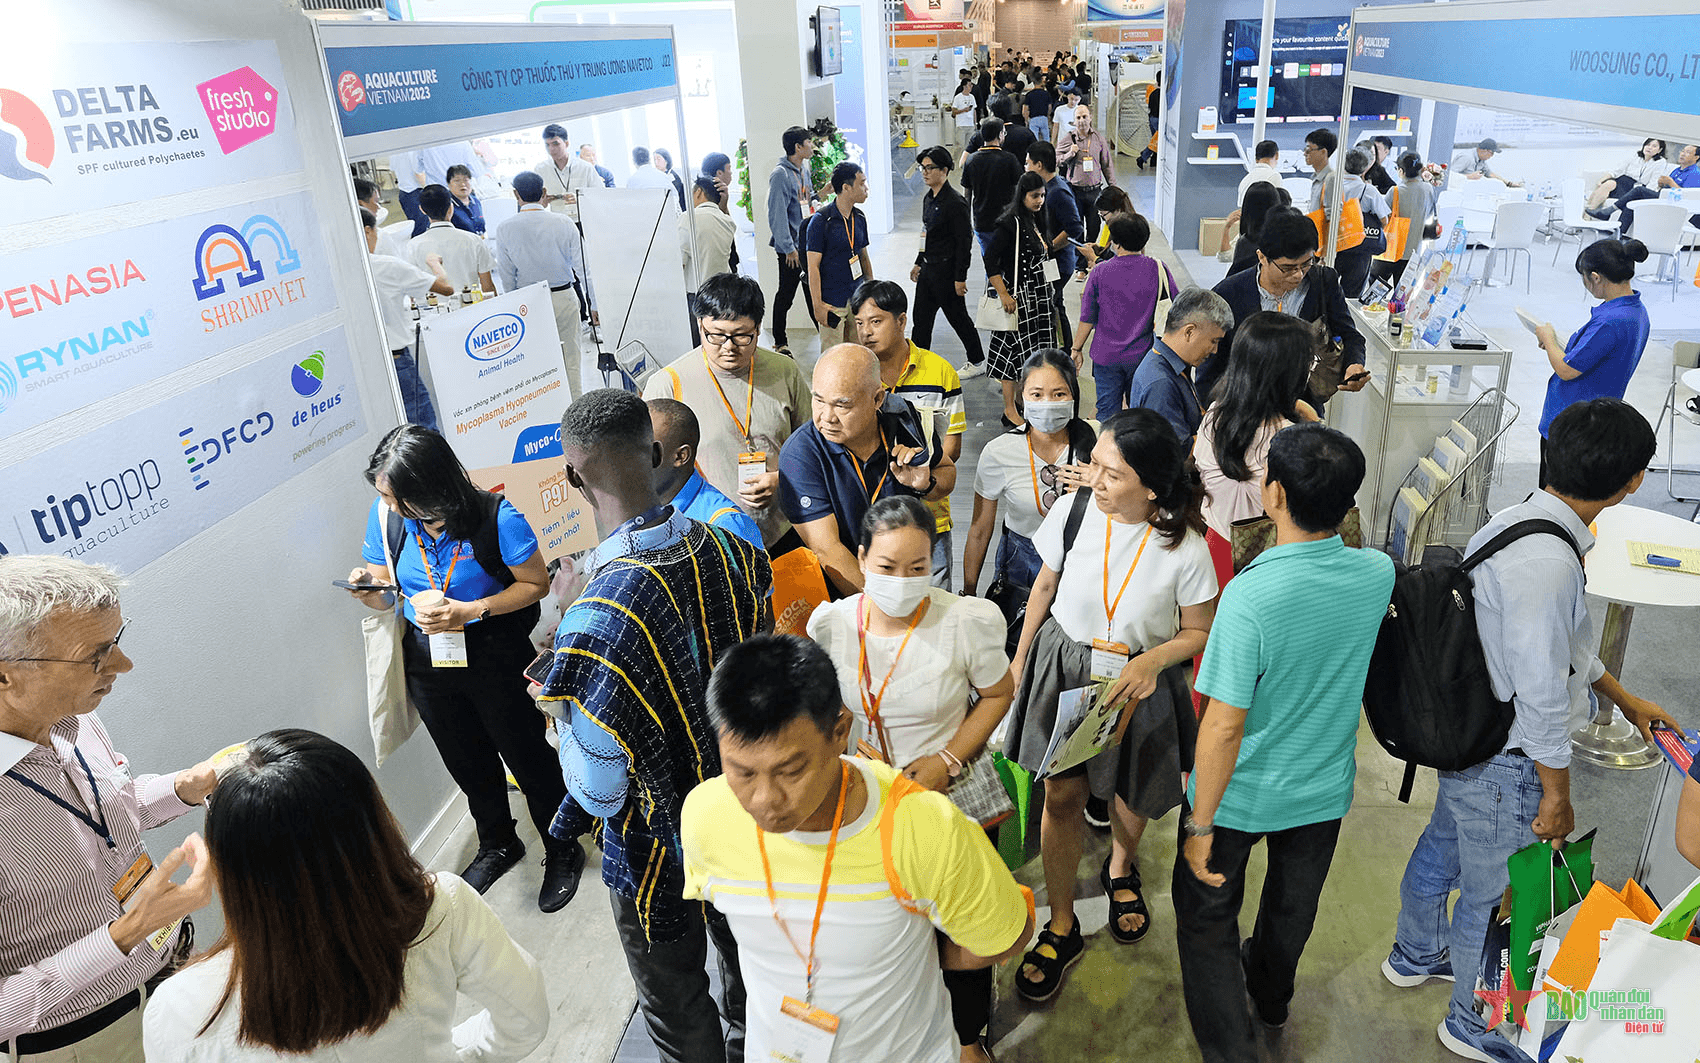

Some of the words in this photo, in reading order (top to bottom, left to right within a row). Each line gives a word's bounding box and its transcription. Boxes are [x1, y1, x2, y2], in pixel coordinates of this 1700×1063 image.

[365, 69, 438, 89] AQUACULTURE
[462, 68, 493, 92] CÔNG
[494, 70, 508, 87] TY
[511, 68, 524, 86] CP
[525, 62, 557, 84] THUỐC
[557, 61, 575, 81] THÚ
[575, 64, 580, 78] Y
[582, 61, 606, 77] TRUNG
[626, 57, 653, 72] NAVETCO
[1569, 50, 1641, 75] WOOSUNG
[1645, 52, 1674, 83] CO.,
[52, 84, 160, 119] DELTA
[206, 87, 254, 111] fresh
[218, 107, 271, 133] studio
[77, 163, 100, 175] SPF
[102, 157, 146, 173] cultured
[148, 149, 206, 166] Polychaetes
[200, 277, 309, 333] SHRIMPVET
[15, 316, 151, 379] RYNAN
[472, 322, 518, 349] NAVETCO
[487, 347, 500, 356] SINCE
[25, 365, 71, 394] SMART
[73, 340, 154, 375] AQUACULTURE
[478, 360, 502, 379] Animal
[503, 353, 525, 368] Health
[532, 367, 558, 381] Mycoplasma
[292, 410, 308, 427] de
[311, 393, 342, 417] heus
[456, 406, 505, 435] Mycoplasma
[506, 380, 561, 411] Hyopneumoniae
[499, 410, 528, 430] Vaccine
[201, 411, 274, 465] DFCD
[293, 437, 326, 463] powering
[327, 420, 356, 441] progress
[31, 458, 162, 544] tiptopp
[540, 478, 568, 513] P97
[548, 536, 562, 549] duy
